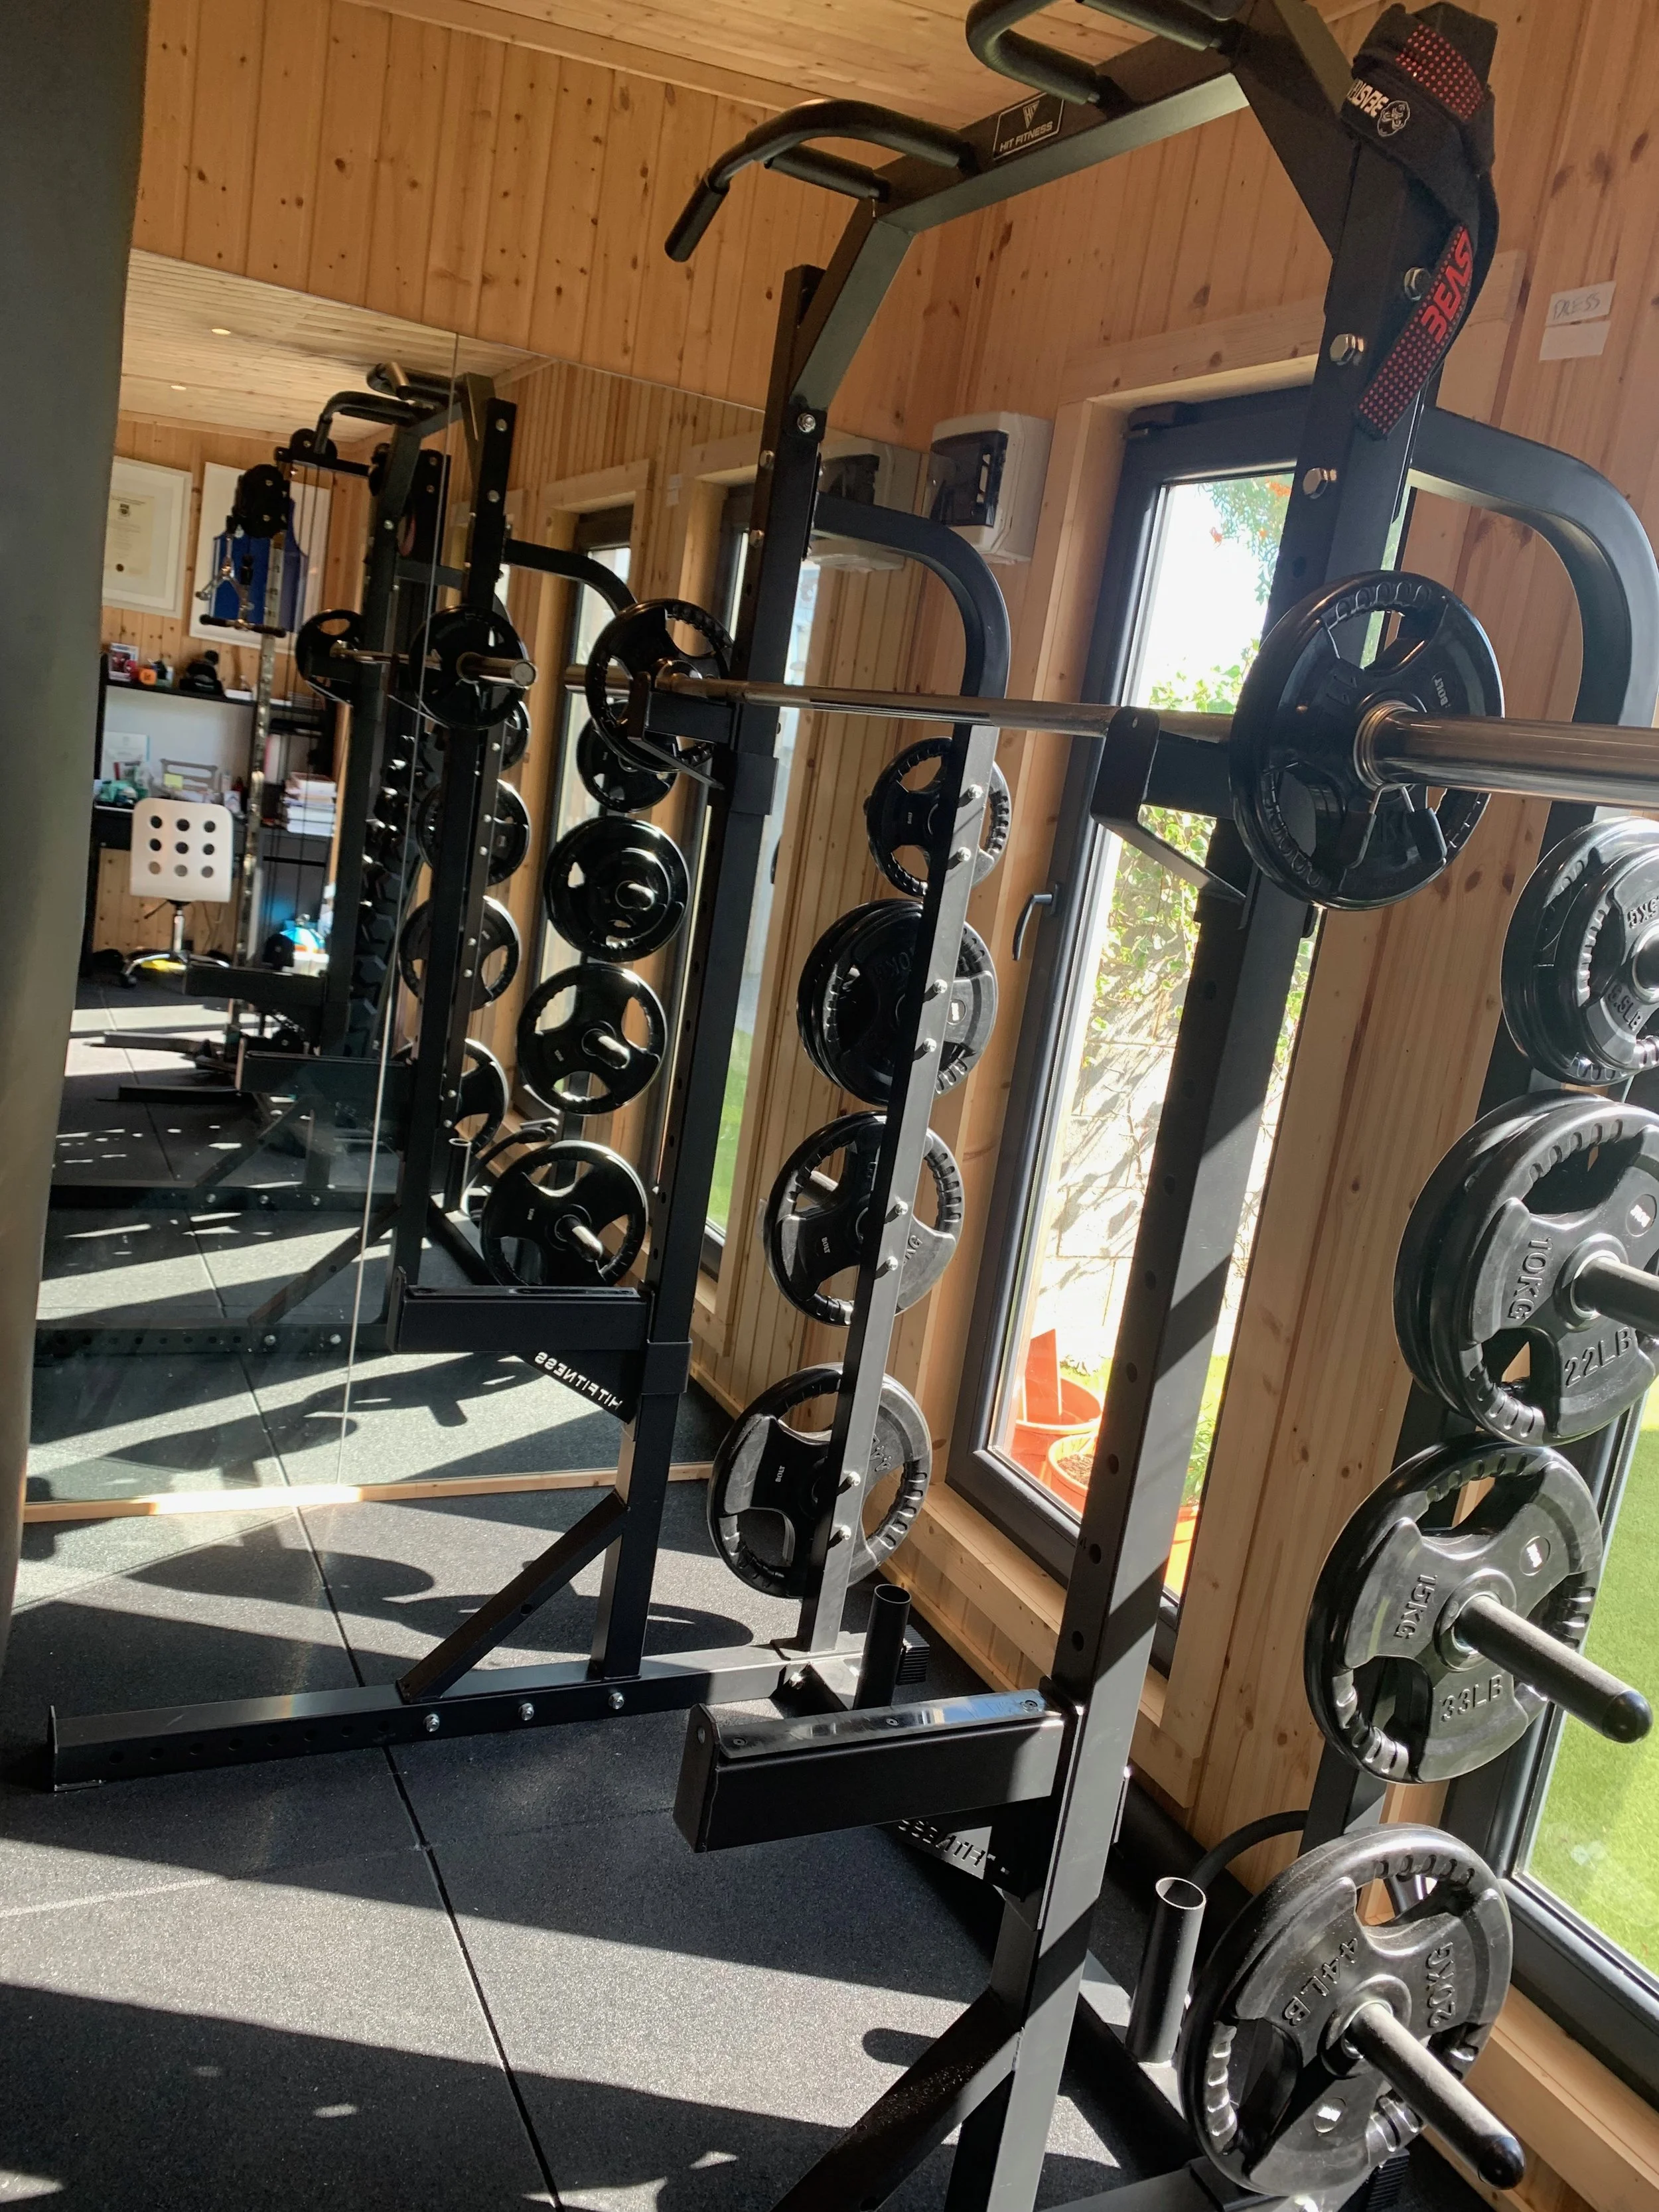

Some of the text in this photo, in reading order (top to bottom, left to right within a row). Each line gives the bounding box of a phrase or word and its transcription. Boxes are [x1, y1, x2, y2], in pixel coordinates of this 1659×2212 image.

[999, 121, 1054, 152] HIT FITNESS
[1421, 229, 1473, 343] BEAS
[1434, 678, 1449, 707] BOLT
[821, 1236, 831, 1254] BOLT
[1508, 1236, 1554, 1321] 10KG
[1564, 1325, 1632, 1388] 22LB
[775, 1465, 786, 1483] BOLT
[1393, 1572, 1439, 1641] 15KG
[1441, 1674, 1504, 1723] 33LB
[1281, 1937, 1358, 2028] 44LB
[1426, 1941, 1456, 2028] 20KG
